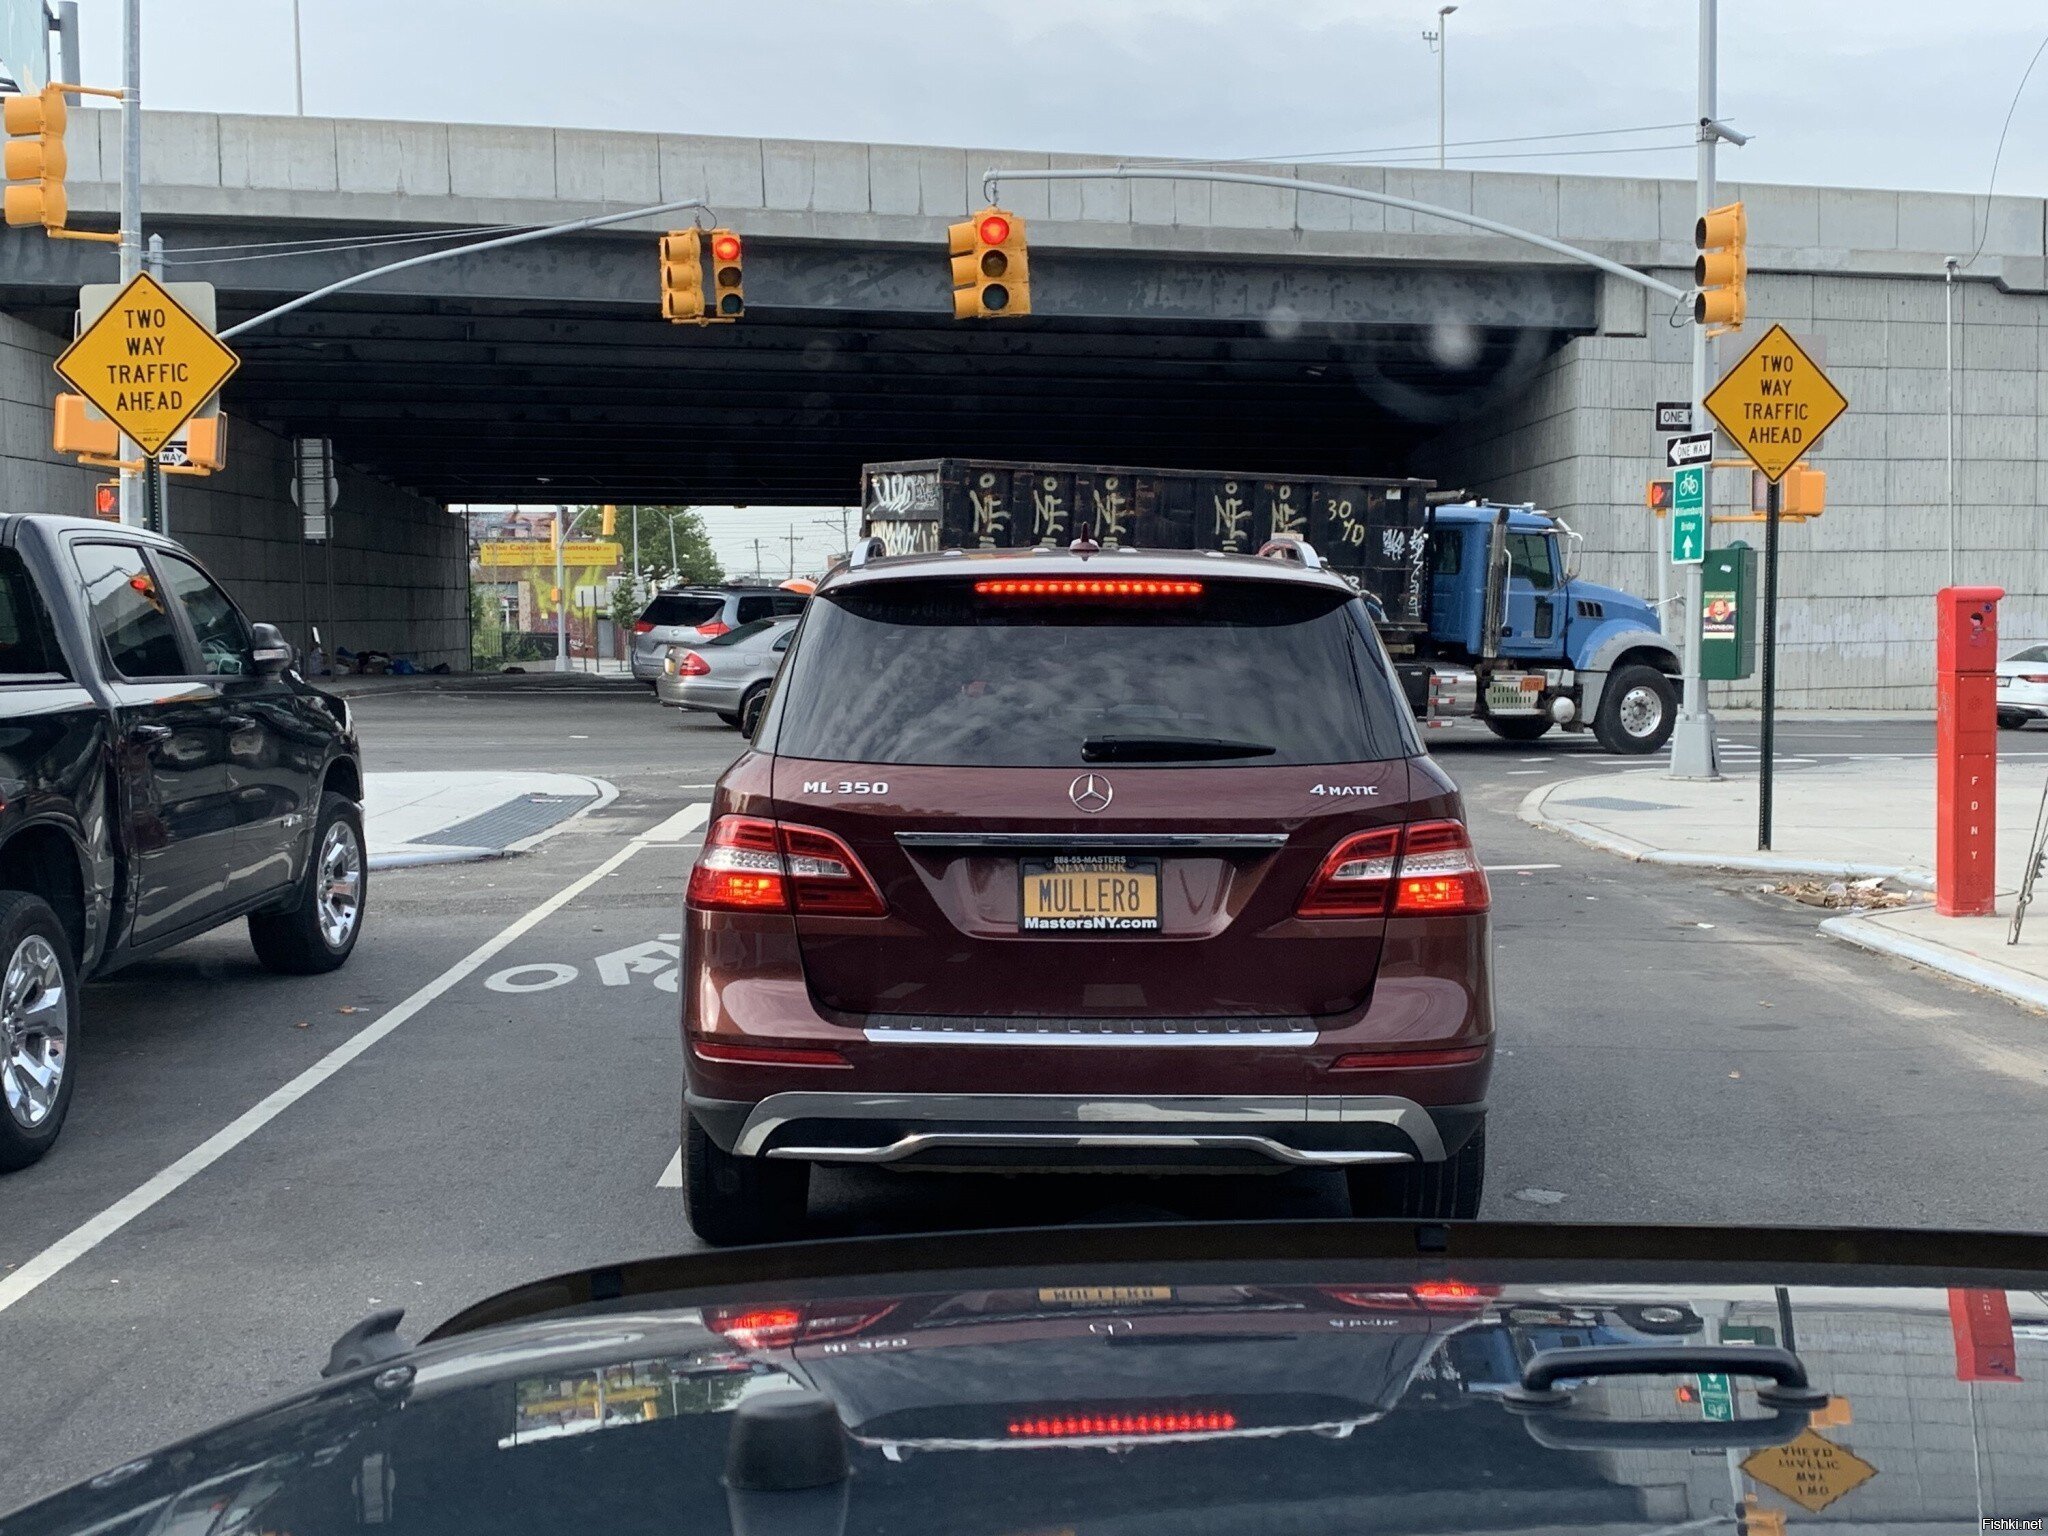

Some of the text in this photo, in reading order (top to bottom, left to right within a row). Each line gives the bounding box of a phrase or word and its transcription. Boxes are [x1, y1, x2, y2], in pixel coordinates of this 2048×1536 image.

[124, 309, 166, 329] TWO
[126, 336, 166, 356] WAY
[1761, 355, 1793, 373] TWO
[106, 363, 189, 384] TRAFFIC
[1760, 379, 1792, 396] WAY
[116, 390, 182, 411] AHEAD
[1663, 411, 1684, 423] ONE
[1743, 402, 1809, 420] TRAFFIC
[1749, 426, 1802, 444] AHEAD
[162, 453, 182, 462] WAY
[1678, 442, 1708, 458] ONE WAY
[1327, 499, 1352, 521] 30
[803, 781, 889, 795] ML 350
[1970, 776, 1979, 860] FDNY
[1054, 863, 1127, 873] NEW YORK
[1038, 878, 1141, 912] MULLER8
[1024, 917, 1158, 930] MastersNY.com
